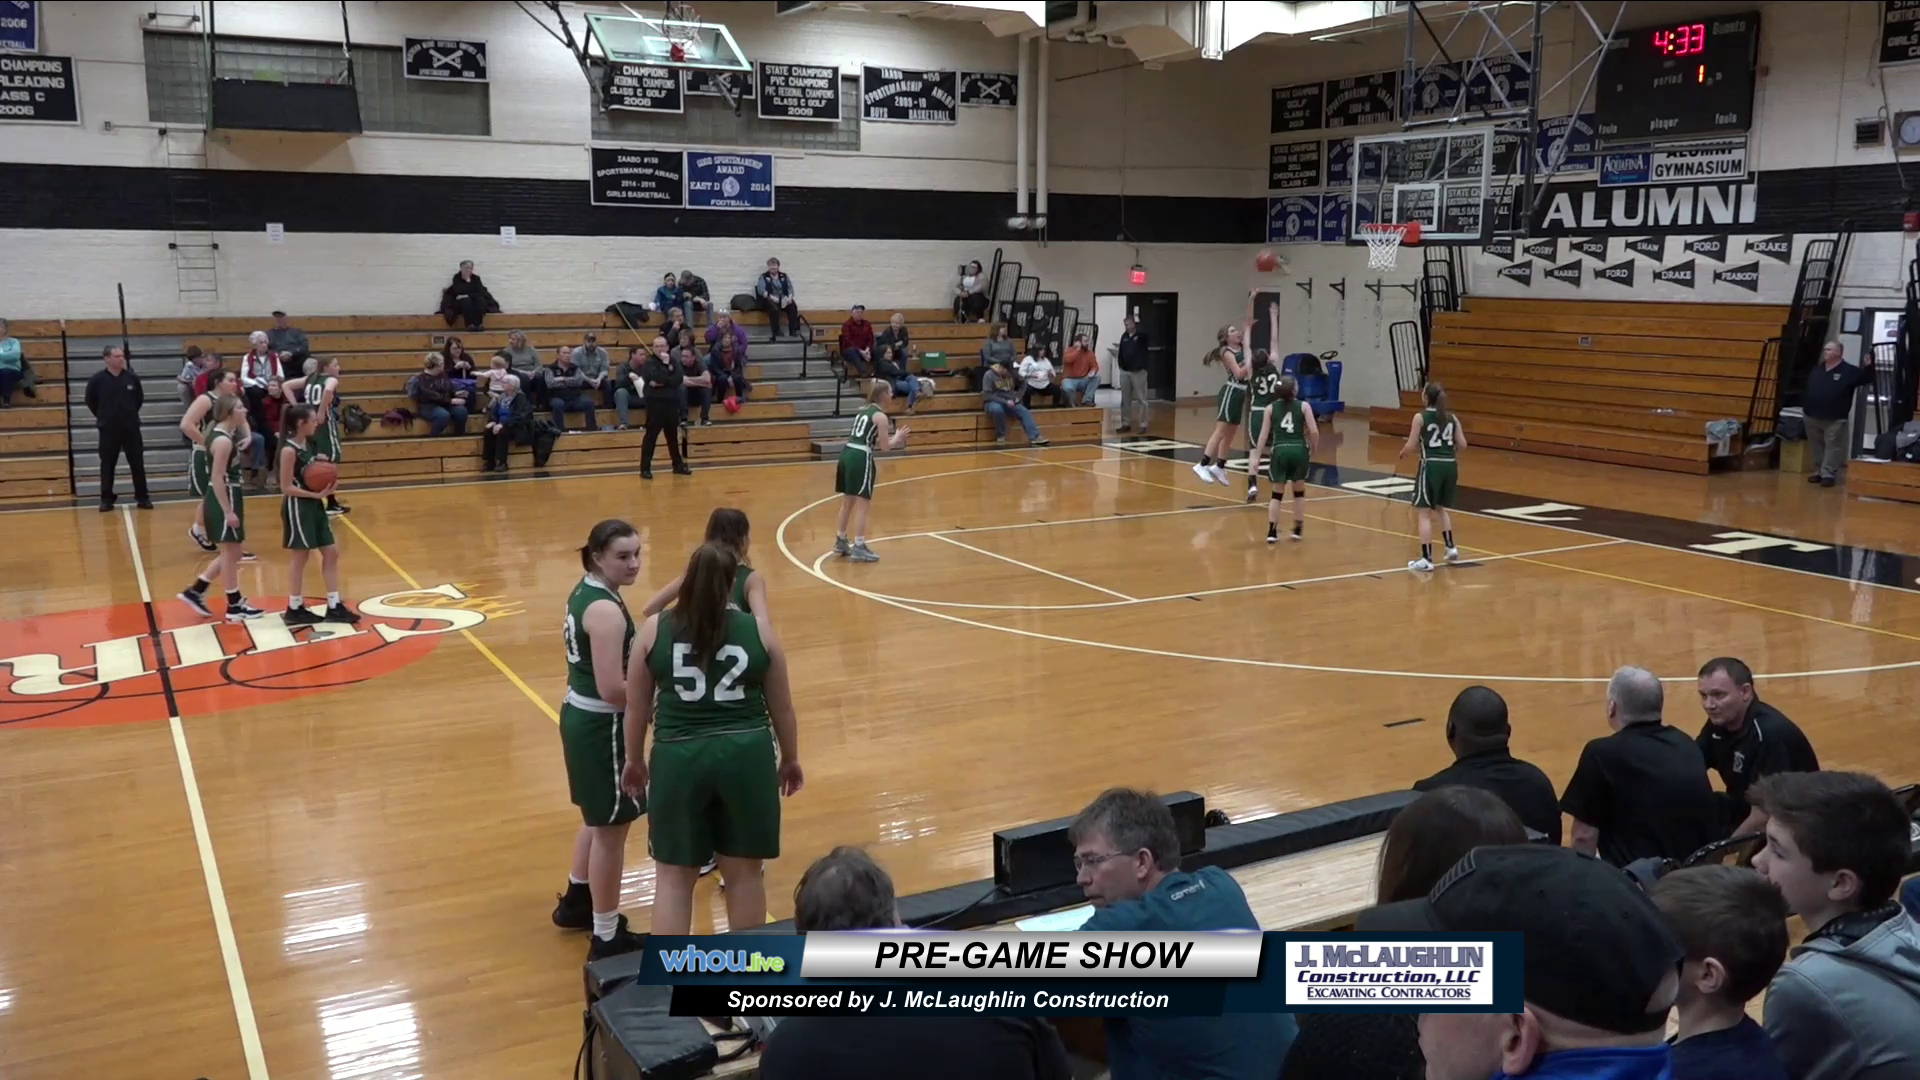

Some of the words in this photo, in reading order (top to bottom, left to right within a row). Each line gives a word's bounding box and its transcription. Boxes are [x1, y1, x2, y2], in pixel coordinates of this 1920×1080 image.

[1654, 24, 1705, 54] 4:33
[1, 59, 63, 74] CHAMPIONS
[622, 65, 669, 78] CHAMPIONS
[765, 64, 789, 76] STATE
[791, 66, 834, 79] CHAMPIONS
[1653, 72, 1684, 89] period
[1697, 65, 1705, 84] 1
[770, 76, 786, 87] PVC
[789, 77, 830, 89] CHAMPIONS
[637, 88, 643, 97] C
[646, 88, 668, 99] GOLF
[773, 97, 798, 107] CLASS
[800, 98, 806, 107] C
[808, 98, 828, 108] GOLF
[1650, 118, 1679, 132] player
[597, 166, 654, 178] SPORTSMANSHIP
[654, 170, 680, 181] AWARD
[716, 166, 746, 175] AWARD
[1655, 159, 1743, 178] GYMNASIUM
[690, 182, 713, 191] EAST
[750, 183, 771, 192] 2014
[606, 190, 627, 199] GIRLS
[627, 191, 671, 200] BASKETBALL
[710, 199, 752, 207] FOOTBALL
[1541, 184, 1758, 229] ALUMNI
[1583, 243, 1604, 253] FORD
[1693, 241, 1721, 252] FORD
[1753, 242, 1788, 253] DRAKE
[1605, 269, 1629, 278] FORD
[1661, 270, 1693, 280] DRAKE
[1721, 272, 1759, 281] PEABODY
[1280, 411, 1295, 433] 4
[1426, 422, 1455, 448] 24
[672, 642, 750, 703] 52
